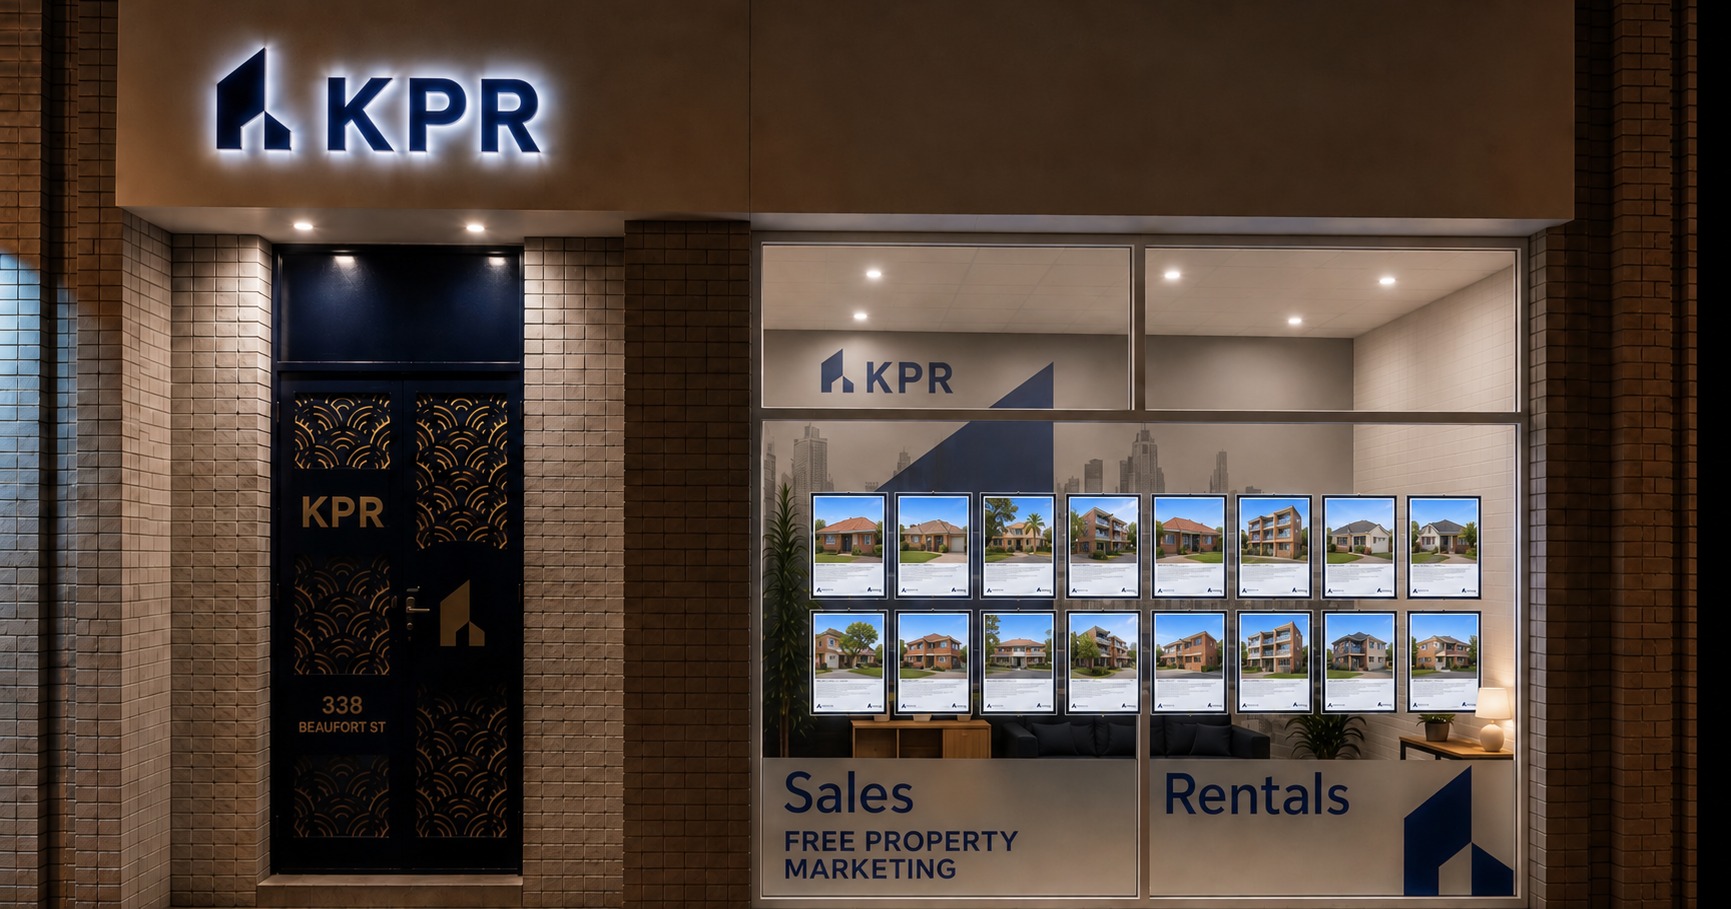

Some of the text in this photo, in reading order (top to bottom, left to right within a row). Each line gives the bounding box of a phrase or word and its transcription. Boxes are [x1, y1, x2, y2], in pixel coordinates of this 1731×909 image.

[327, 77, 540, 152] KPR
[866, 361, 953, 393] KPR
[302, 496, 384, 528] KPR
[322, 695, 363, 714] 338
[298, 721, 386, 733] BEAUFORT ST
[784, 770, 913, 814] Sales
[1165, 771, 1350, 816] Rentals
[785, 830, 1019, 852] FREE PROPERTY
[785, 858, 957, 880] MARKETING
